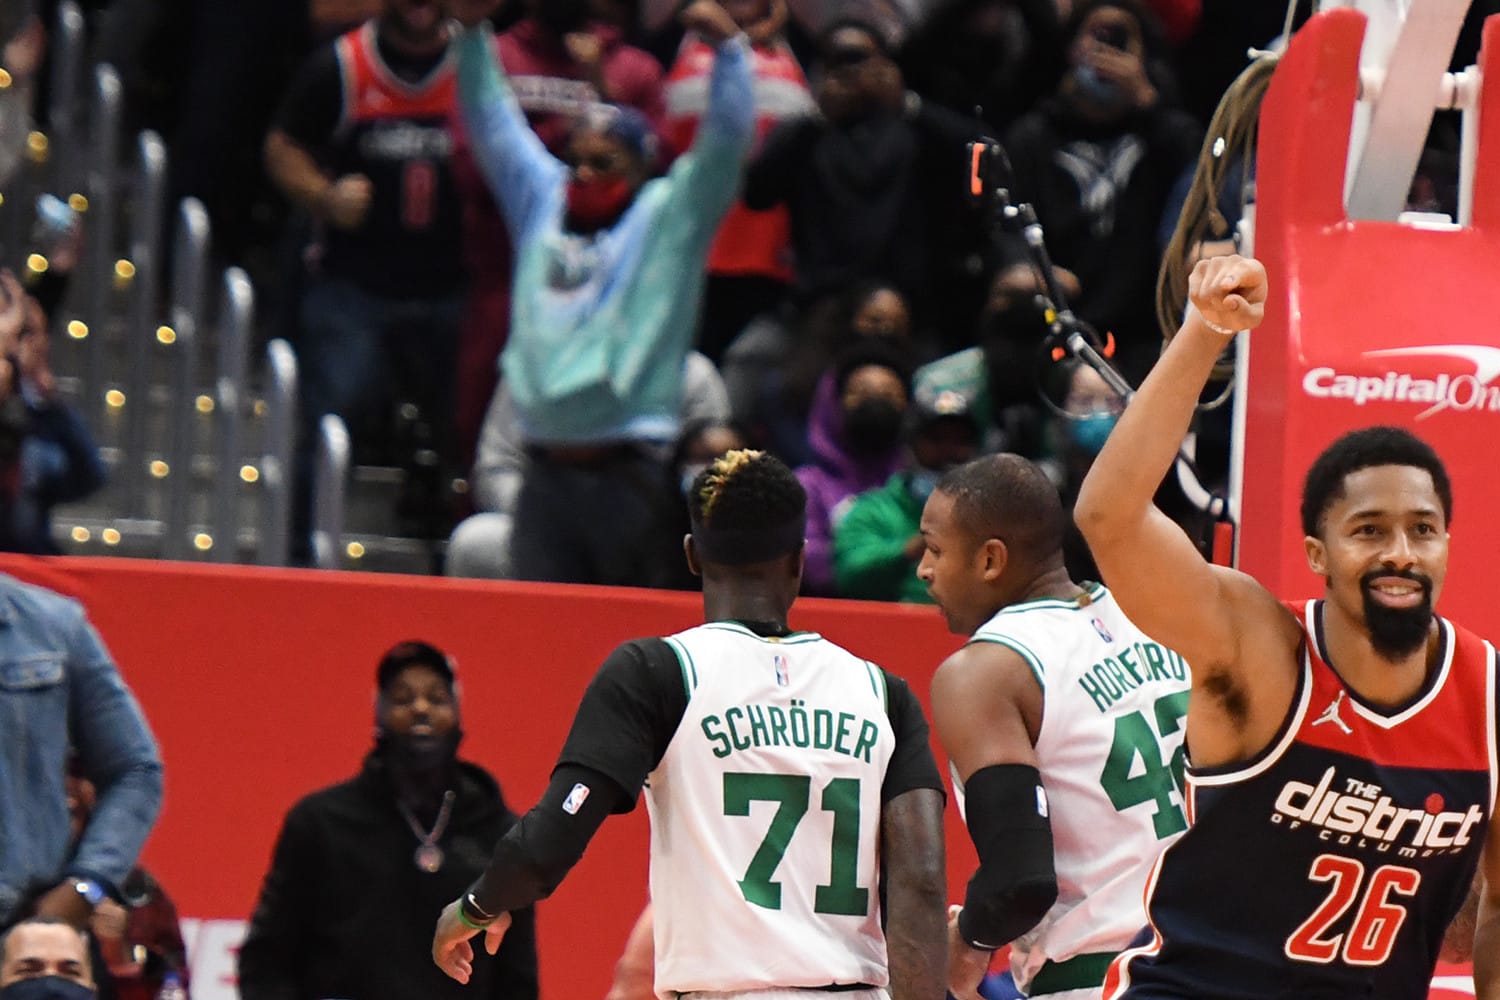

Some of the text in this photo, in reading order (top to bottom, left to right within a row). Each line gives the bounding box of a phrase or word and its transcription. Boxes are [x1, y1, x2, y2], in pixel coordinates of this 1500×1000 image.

[1078, 641, 1186, 713] HORFORD
[701, 699, 879, 764] SCHRÖDER
[1270, 812, 1301, 830] OF
[1274, 766, 1483, 848] district
[1345, 777, 1382, 800] THE
[723, 771, 869, 917] 71
[1285, 853, 1421, 967] 26
